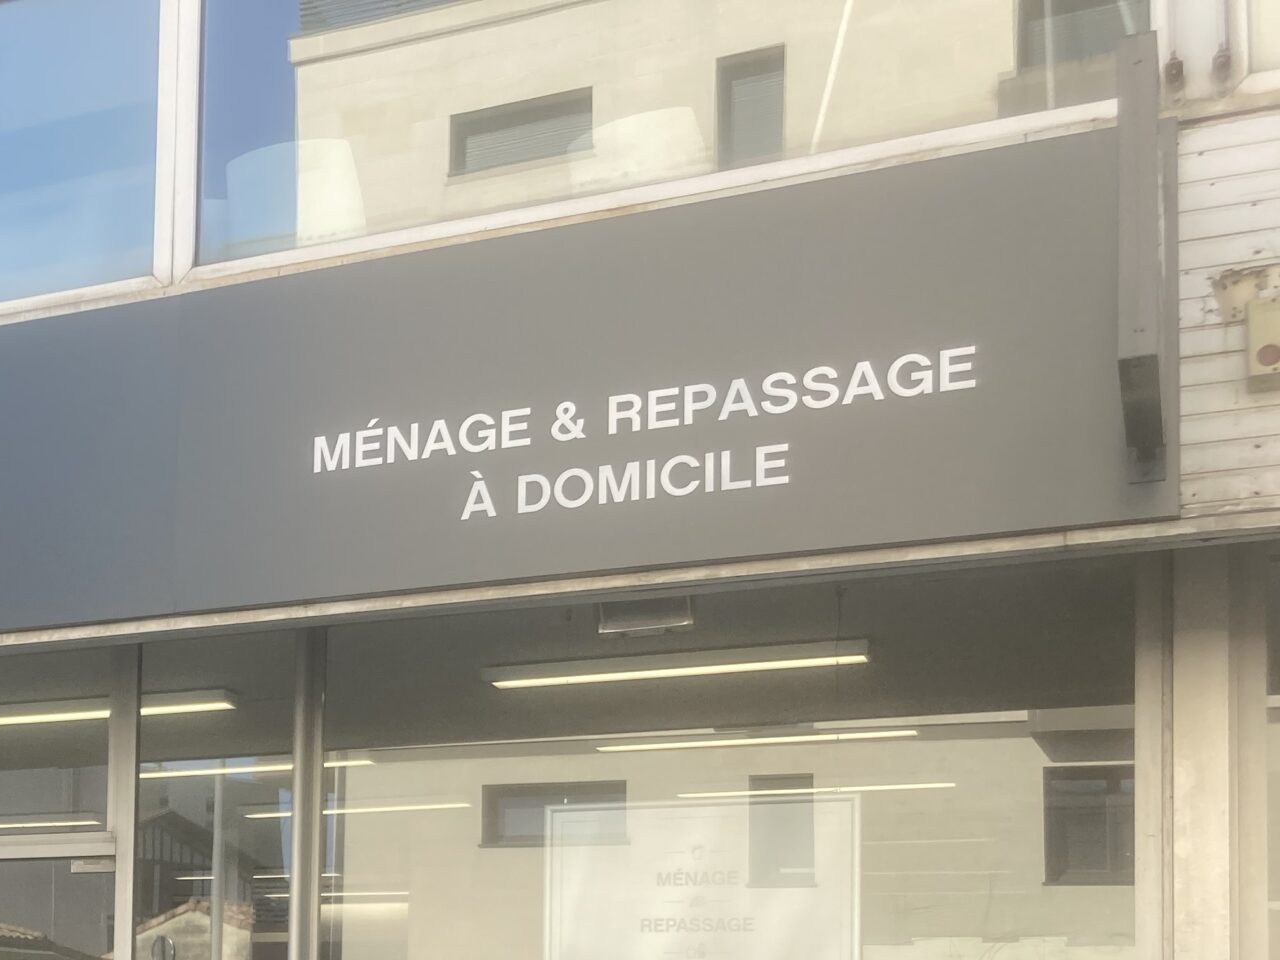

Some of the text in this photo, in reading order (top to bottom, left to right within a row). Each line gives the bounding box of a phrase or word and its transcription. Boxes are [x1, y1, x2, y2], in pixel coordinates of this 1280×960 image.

[312, 344, 978, 474] MÉNAGE & REPASSAGE
[460, 442, 791, 521] À DOMICILE
[656, 868, 739, 887] MÉNAGE
[639, 917, 755, 934] REPASSAGE
